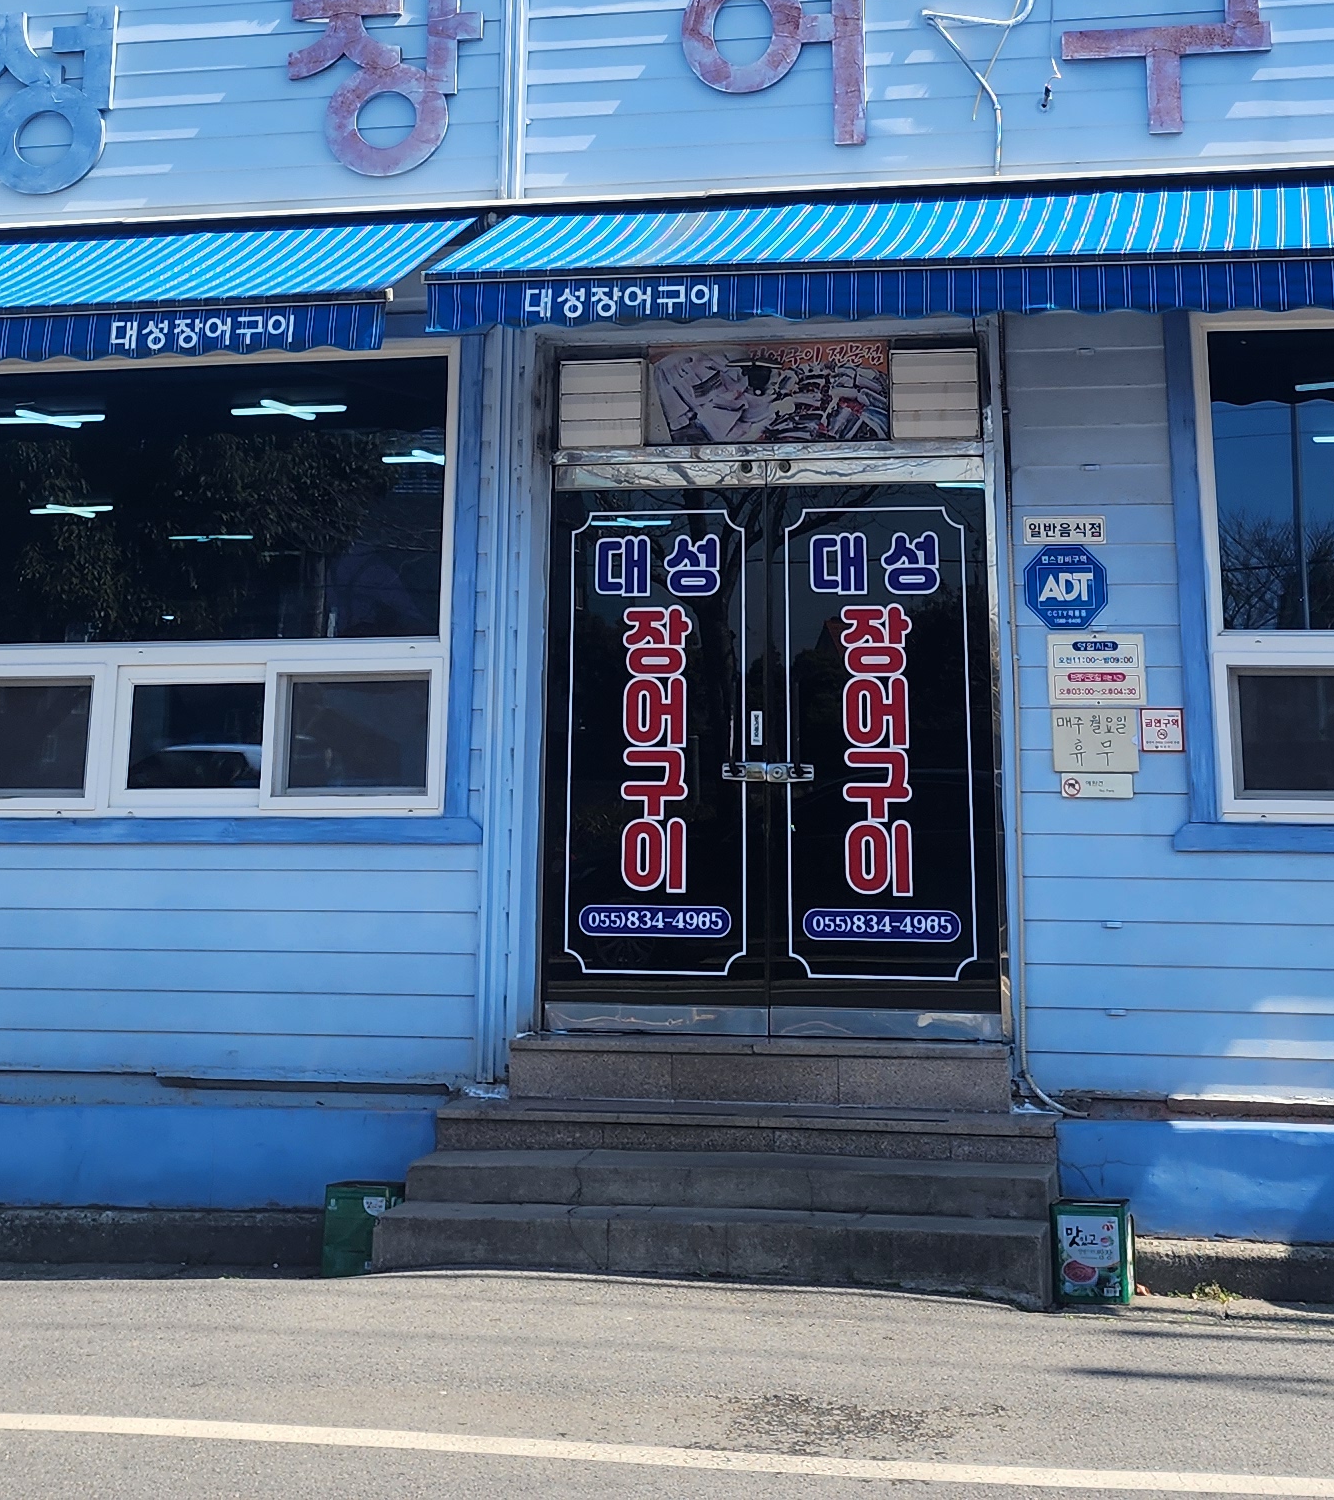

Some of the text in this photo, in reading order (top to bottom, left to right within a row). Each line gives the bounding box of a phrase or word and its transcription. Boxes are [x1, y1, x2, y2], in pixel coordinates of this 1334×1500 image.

[524, 284, 720, 319] 대성장어구이
[109, 314, 295, 351] 대성장어구이
[1028, 522, 1102, 538] 일반음식점
[595, 534, 721, 596] 대성
[809, 531, 941, 595] 대성
[1039, 572, 1093, 602] ADT
[1077, 642, 1114, 651] 영업시간
[1056, 714, 1127, 735] 매주 월요일
[1144, 718, 1180, 728] 금연구역
[621, 605, 693, 893] 장어구이
[840, 603, 913, 897] 장어구이
